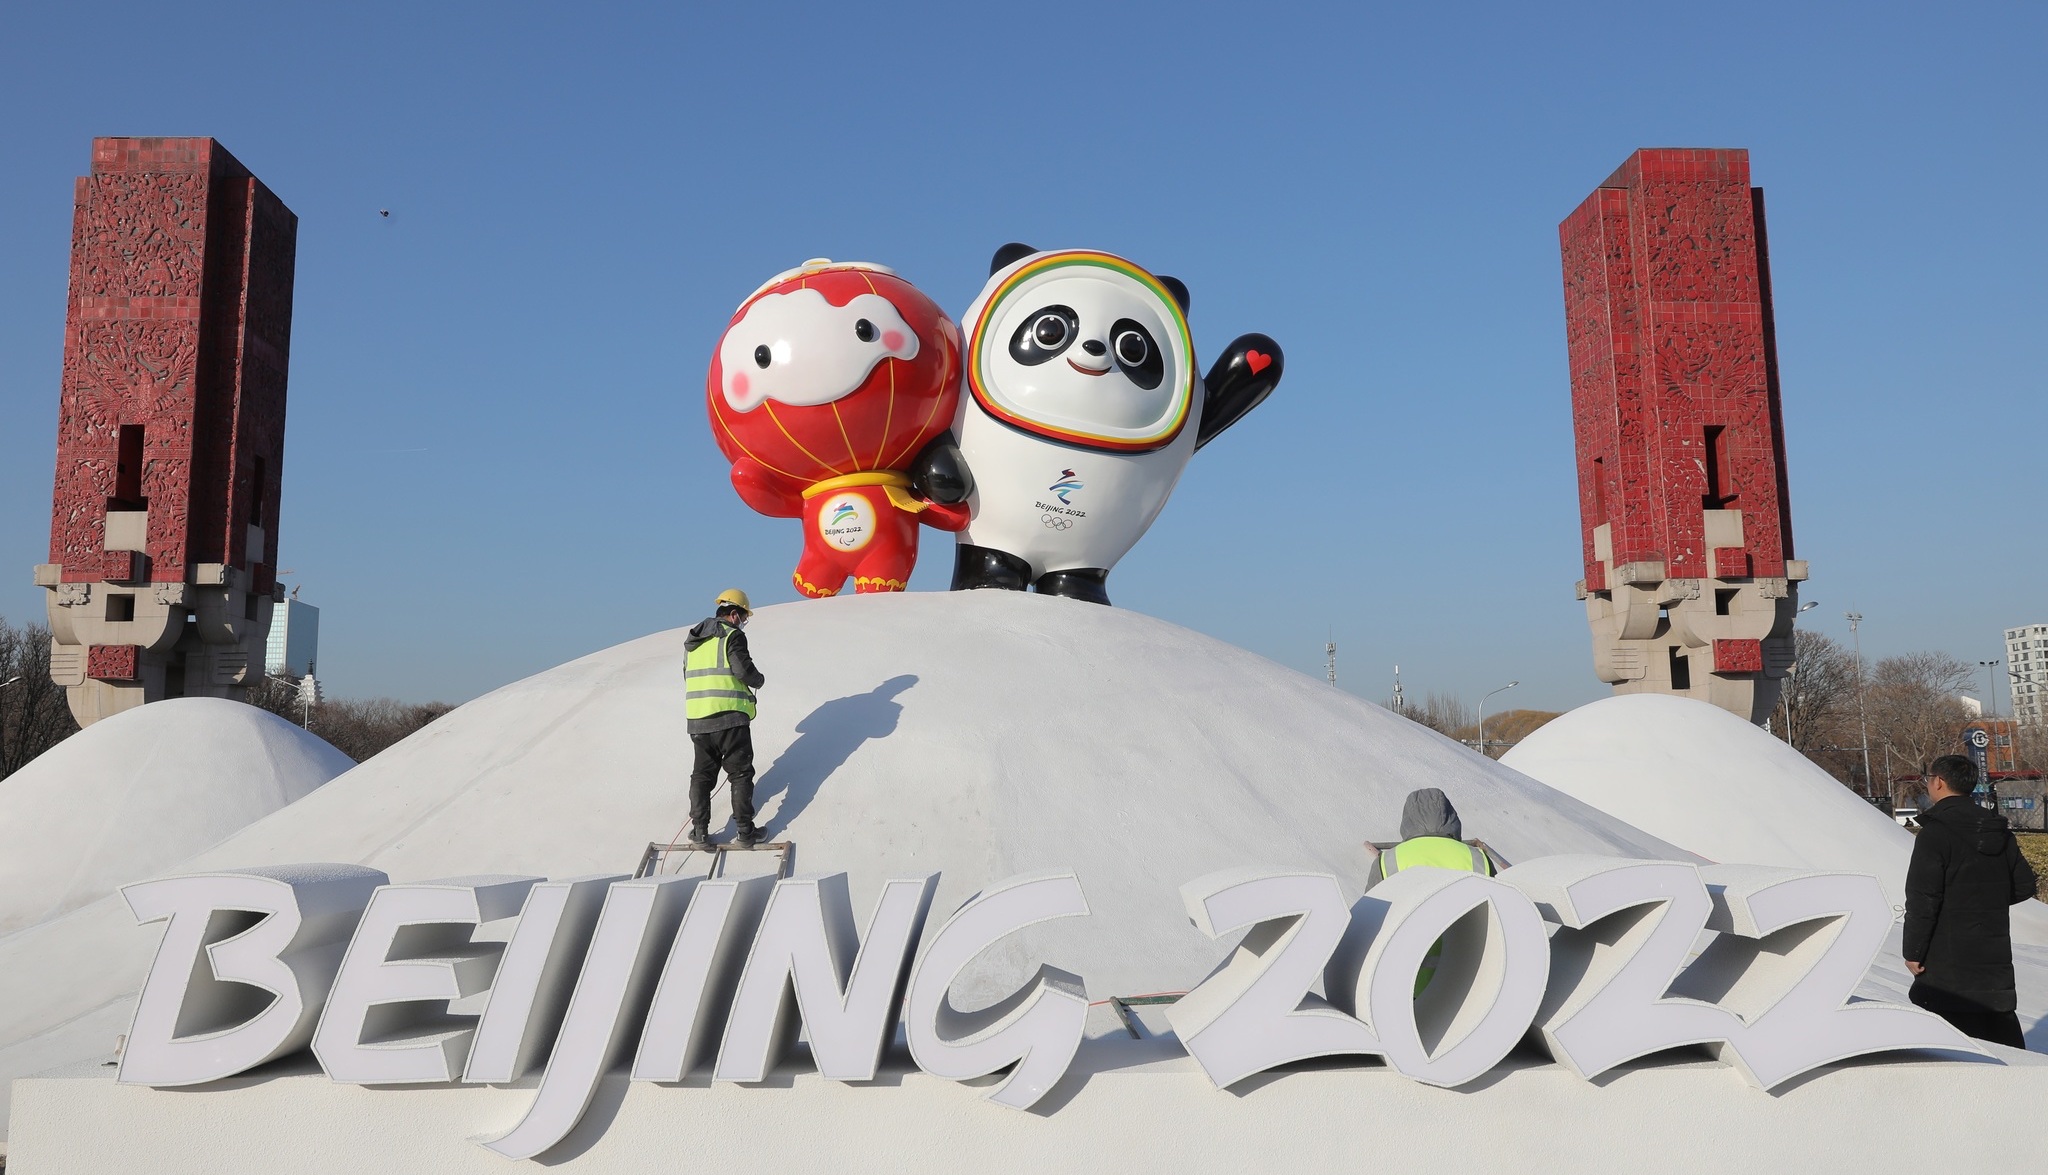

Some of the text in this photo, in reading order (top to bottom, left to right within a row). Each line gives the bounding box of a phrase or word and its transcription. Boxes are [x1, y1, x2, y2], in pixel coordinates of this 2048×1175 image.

[1035, 501, 1086, 517] BEIJING 2022
[825, 528, 844, 536] BEIJING
[117, 860, 1999, 1160] BEIJING 2022
